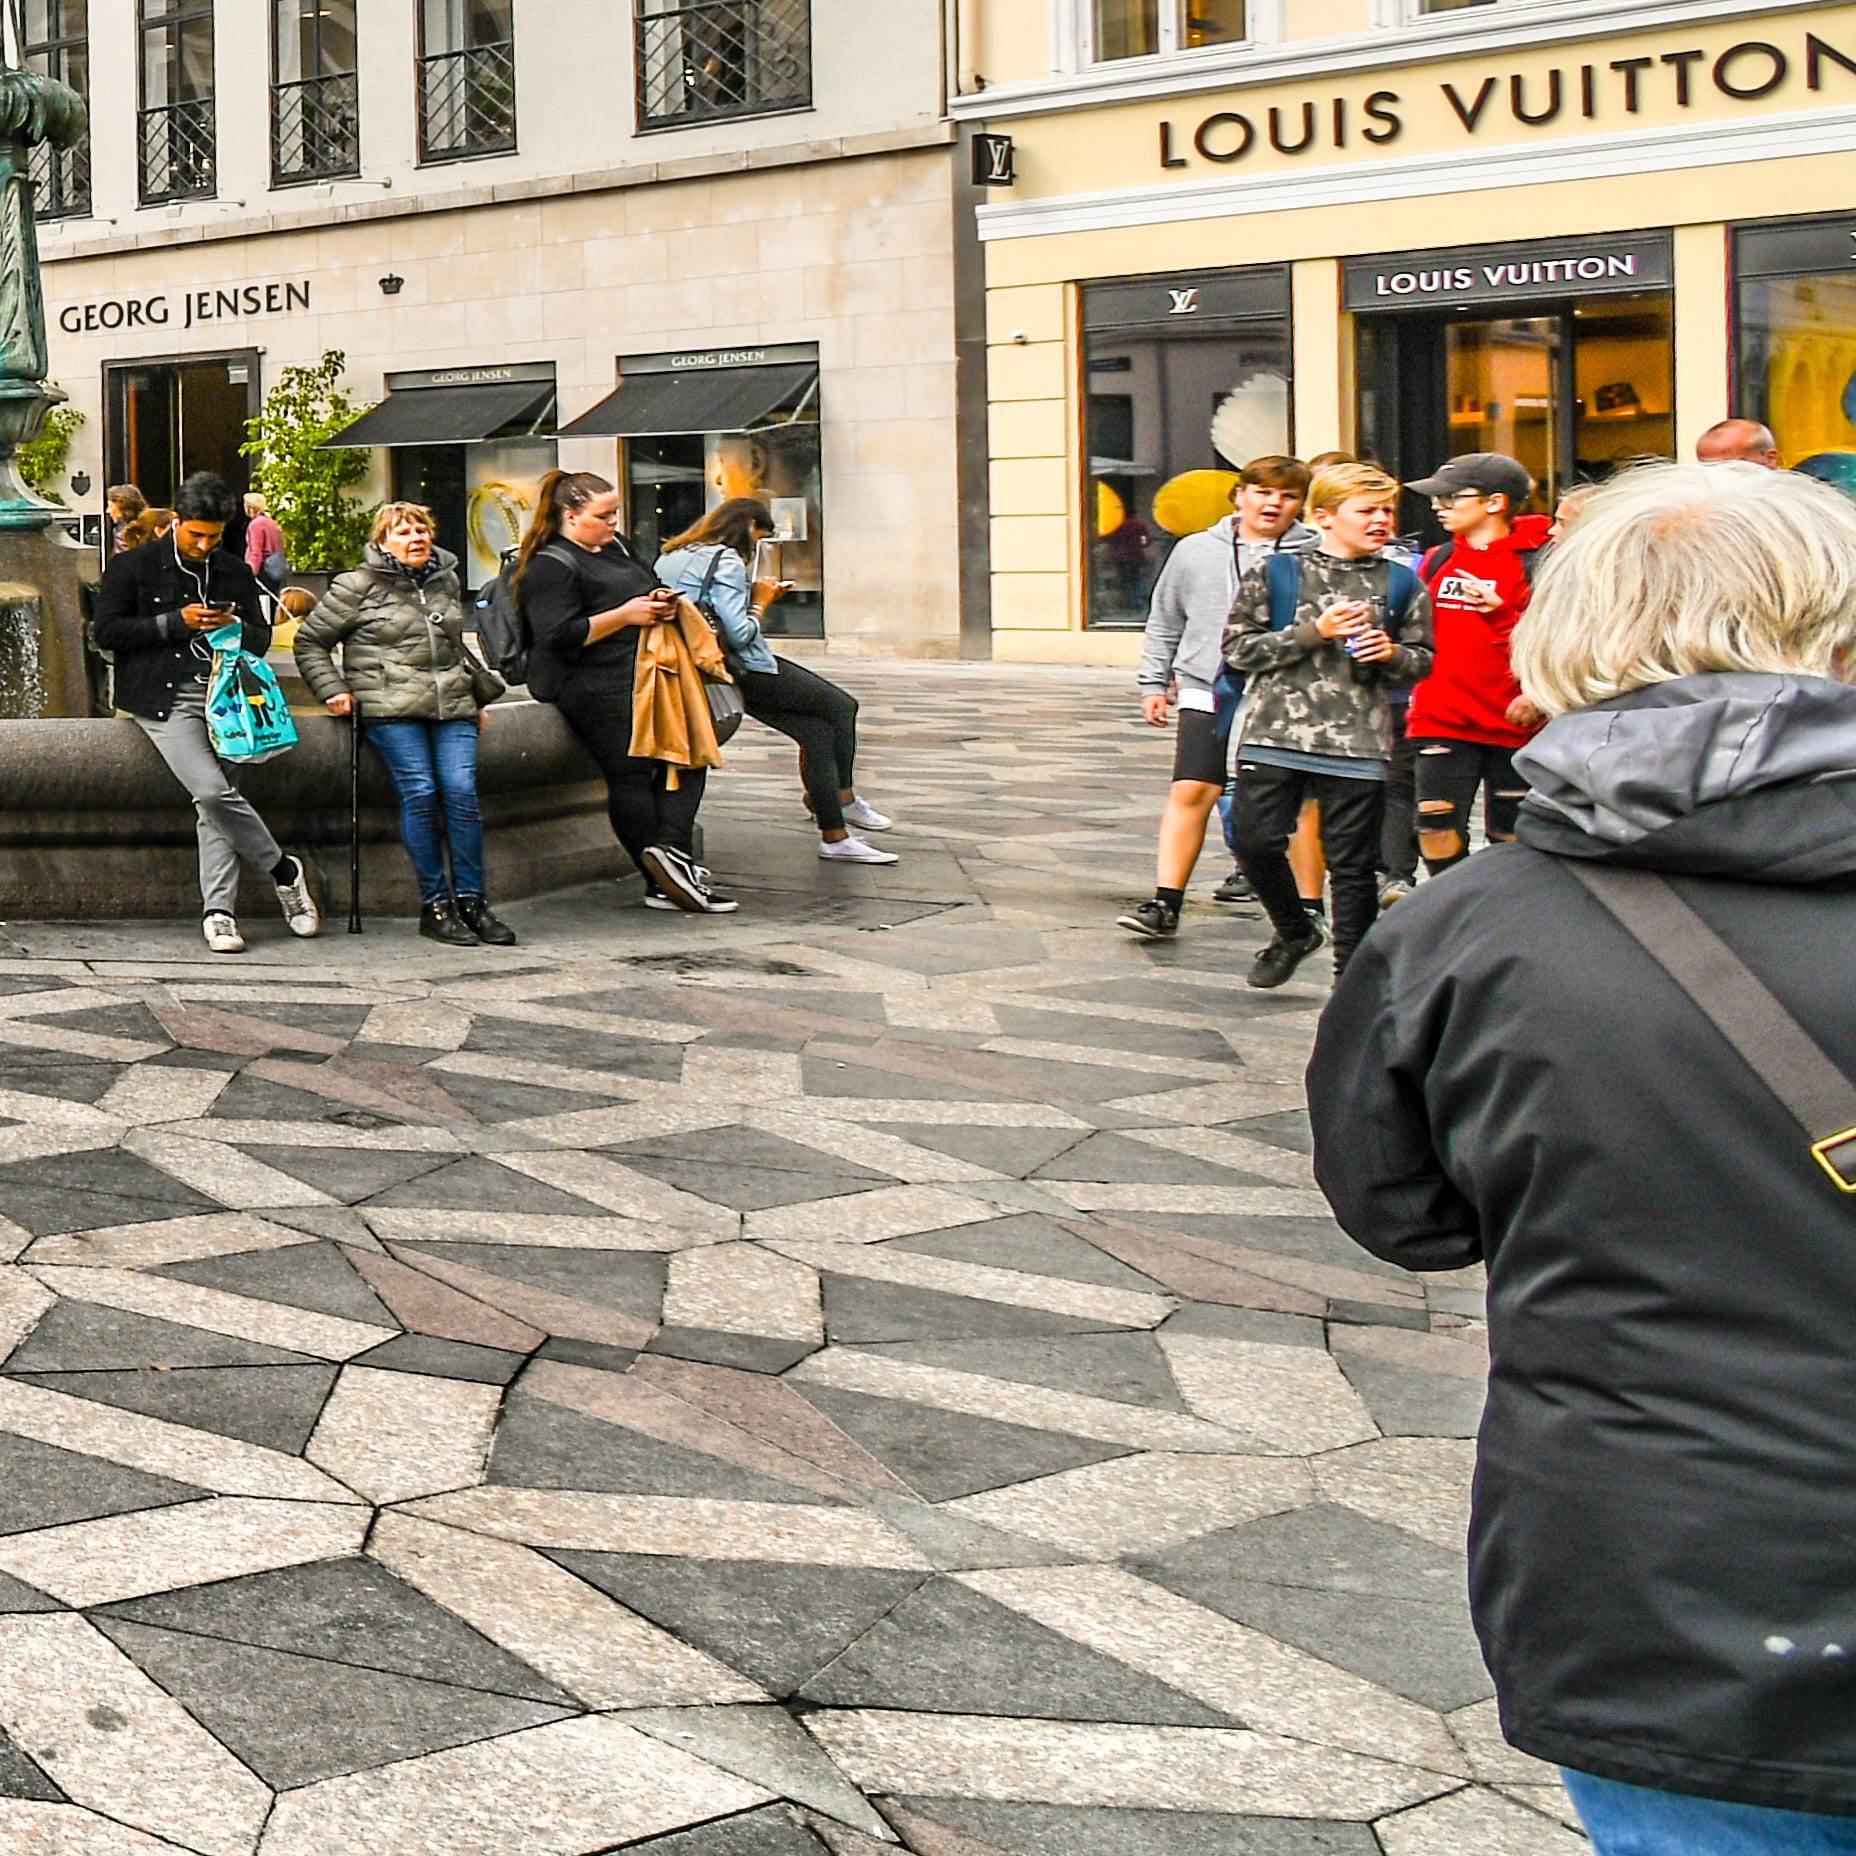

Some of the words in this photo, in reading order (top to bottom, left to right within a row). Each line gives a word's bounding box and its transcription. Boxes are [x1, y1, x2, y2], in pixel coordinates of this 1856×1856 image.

[1159, 90, 1402, 168] LOUIS
[1440, 31, 1856, 135] VUITTON
[1376, 268, 1473, 296] LOUIS
[1483, 254, 1635, 287] VUITTON
[59, 296, 169, 333] GEORG
[184, 280, 311, 329] JENSEN
[431, 372, 469, 383] GEORG
[472, 369, 511, 382] JENSEN
[670, 354, 716, 366] GEORG
[718, 351, 765, 366] JENSEN
